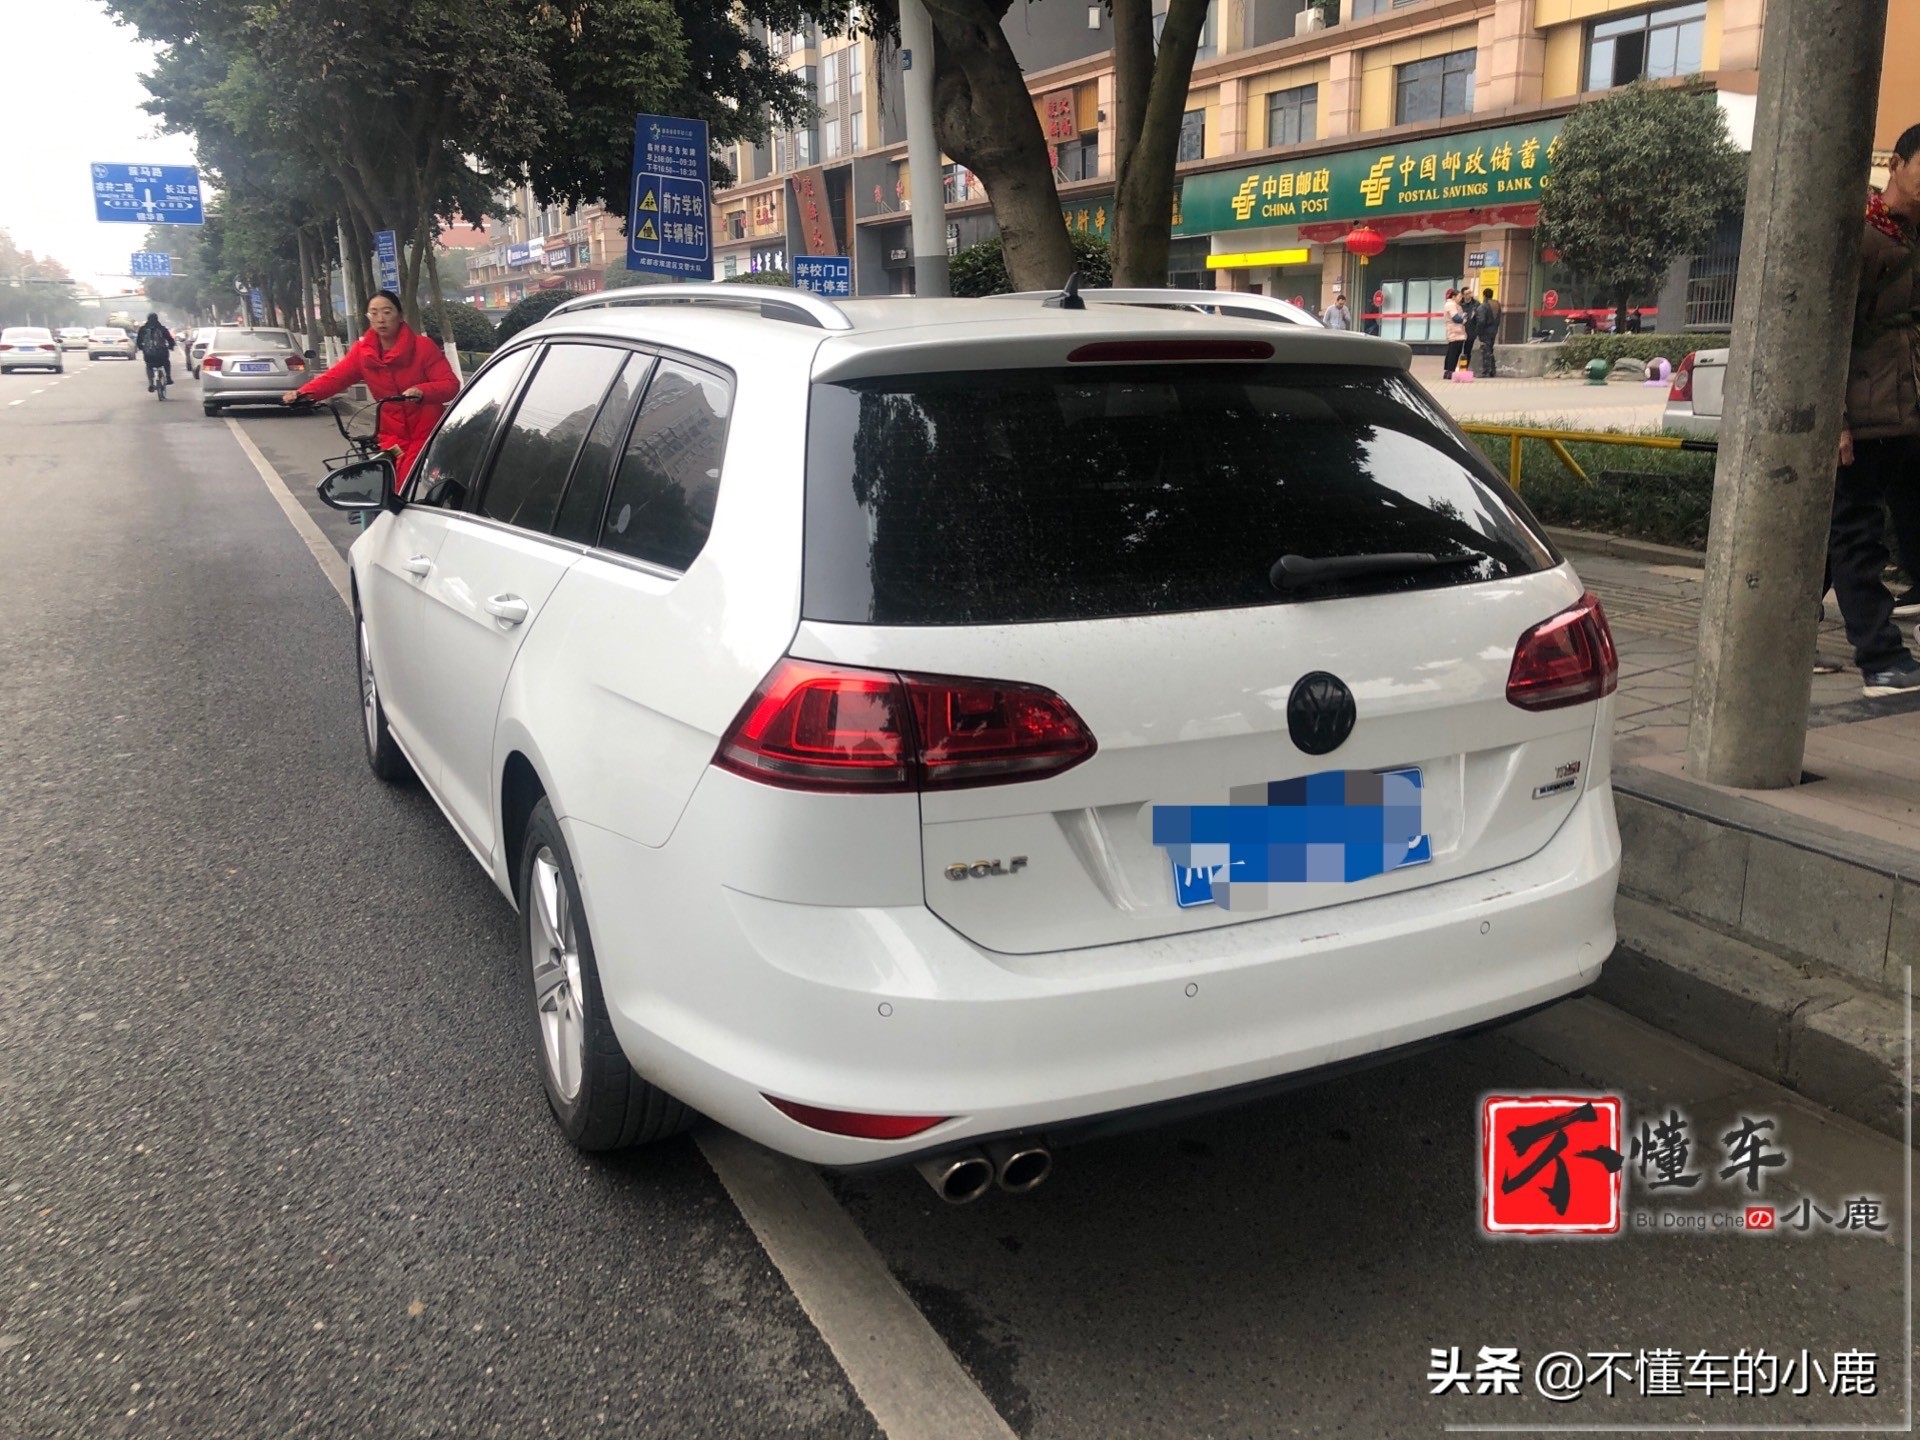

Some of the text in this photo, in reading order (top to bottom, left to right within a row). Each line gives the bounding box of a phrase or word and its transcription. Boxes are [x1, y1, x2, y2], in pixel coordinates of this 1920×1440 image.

[164, 184, 198, 195] 长江路
[1262, 168, 1330, 200] 中国邮政
[1398, 187, 1440, 204] POSTAL
[1442, 182, 1489, 199] SAVINGS
[1498, 176, 1533, 193] BANK
[662, 191, 703, 217] 前方学校
[1262, 198, 1329, 218] CHINA POST
[663, 221, 704, 247] 车辆慢行
[796, 263, 848, 277] 学校门口
[796, 279, 849, 293] 禁止停车
[944, 855, 1028, 881] GOLF
